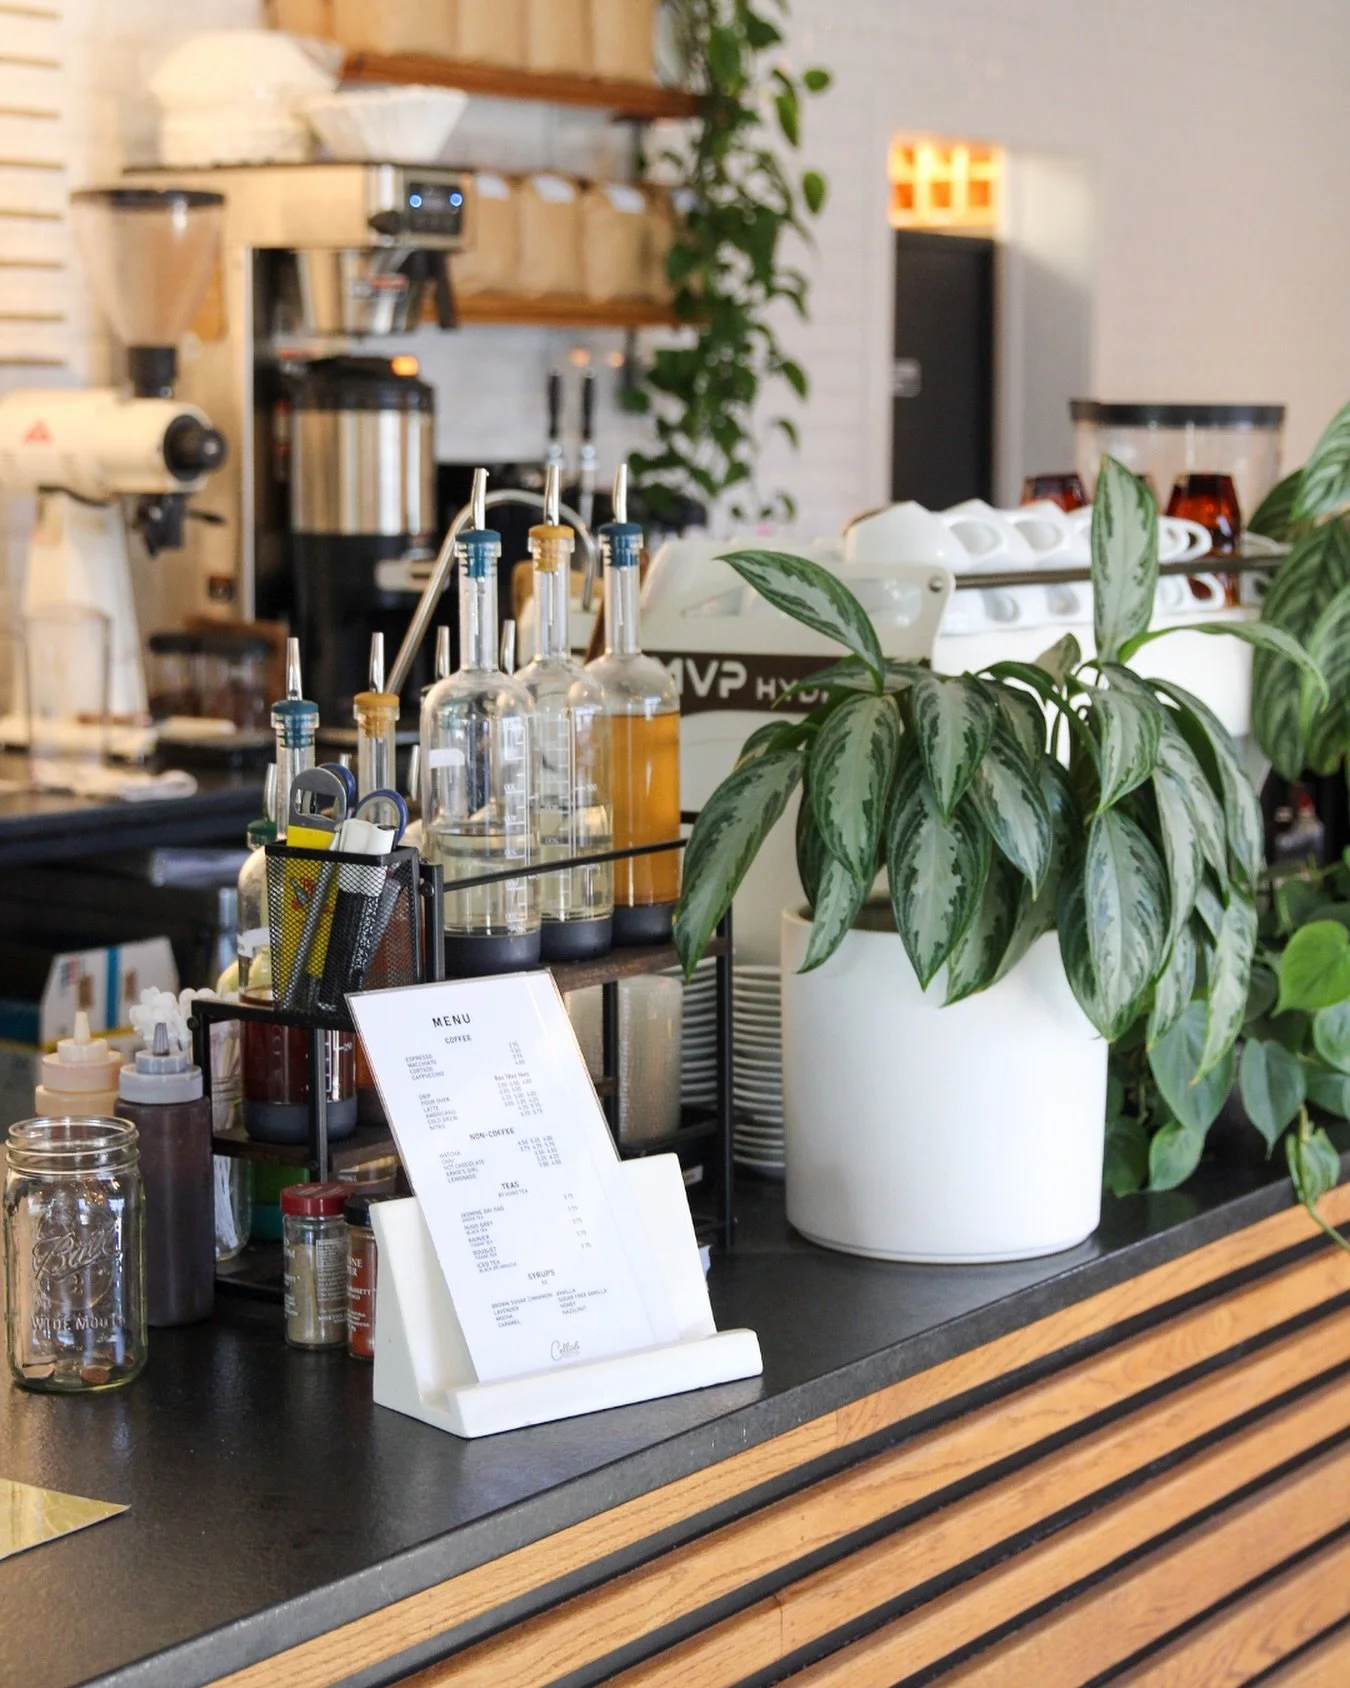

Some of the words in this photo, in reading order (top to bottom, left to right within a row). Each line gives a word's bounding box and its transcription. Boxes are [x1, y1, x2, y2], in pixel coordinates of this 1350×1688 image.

[432, 1013, 472, 1028] MENU
[444, 1034, 472, 1044] COFFEE
[405, 1054, 433, 1062] ESPRESSO
[426, 1110, 456, 1119] AMERICANO
[469, 1127, 515, 1140] NON-COFFEE
[455, 1159, 485, 1169] CHOCOLATE
[501, 1181, 520, 1190] TEAS
[528, 1269, 556, 1280] SYRUPS
[493, 1306, 519, 1316] LAVENDER
[498, 1319, 520, 1328] CARAMEL
